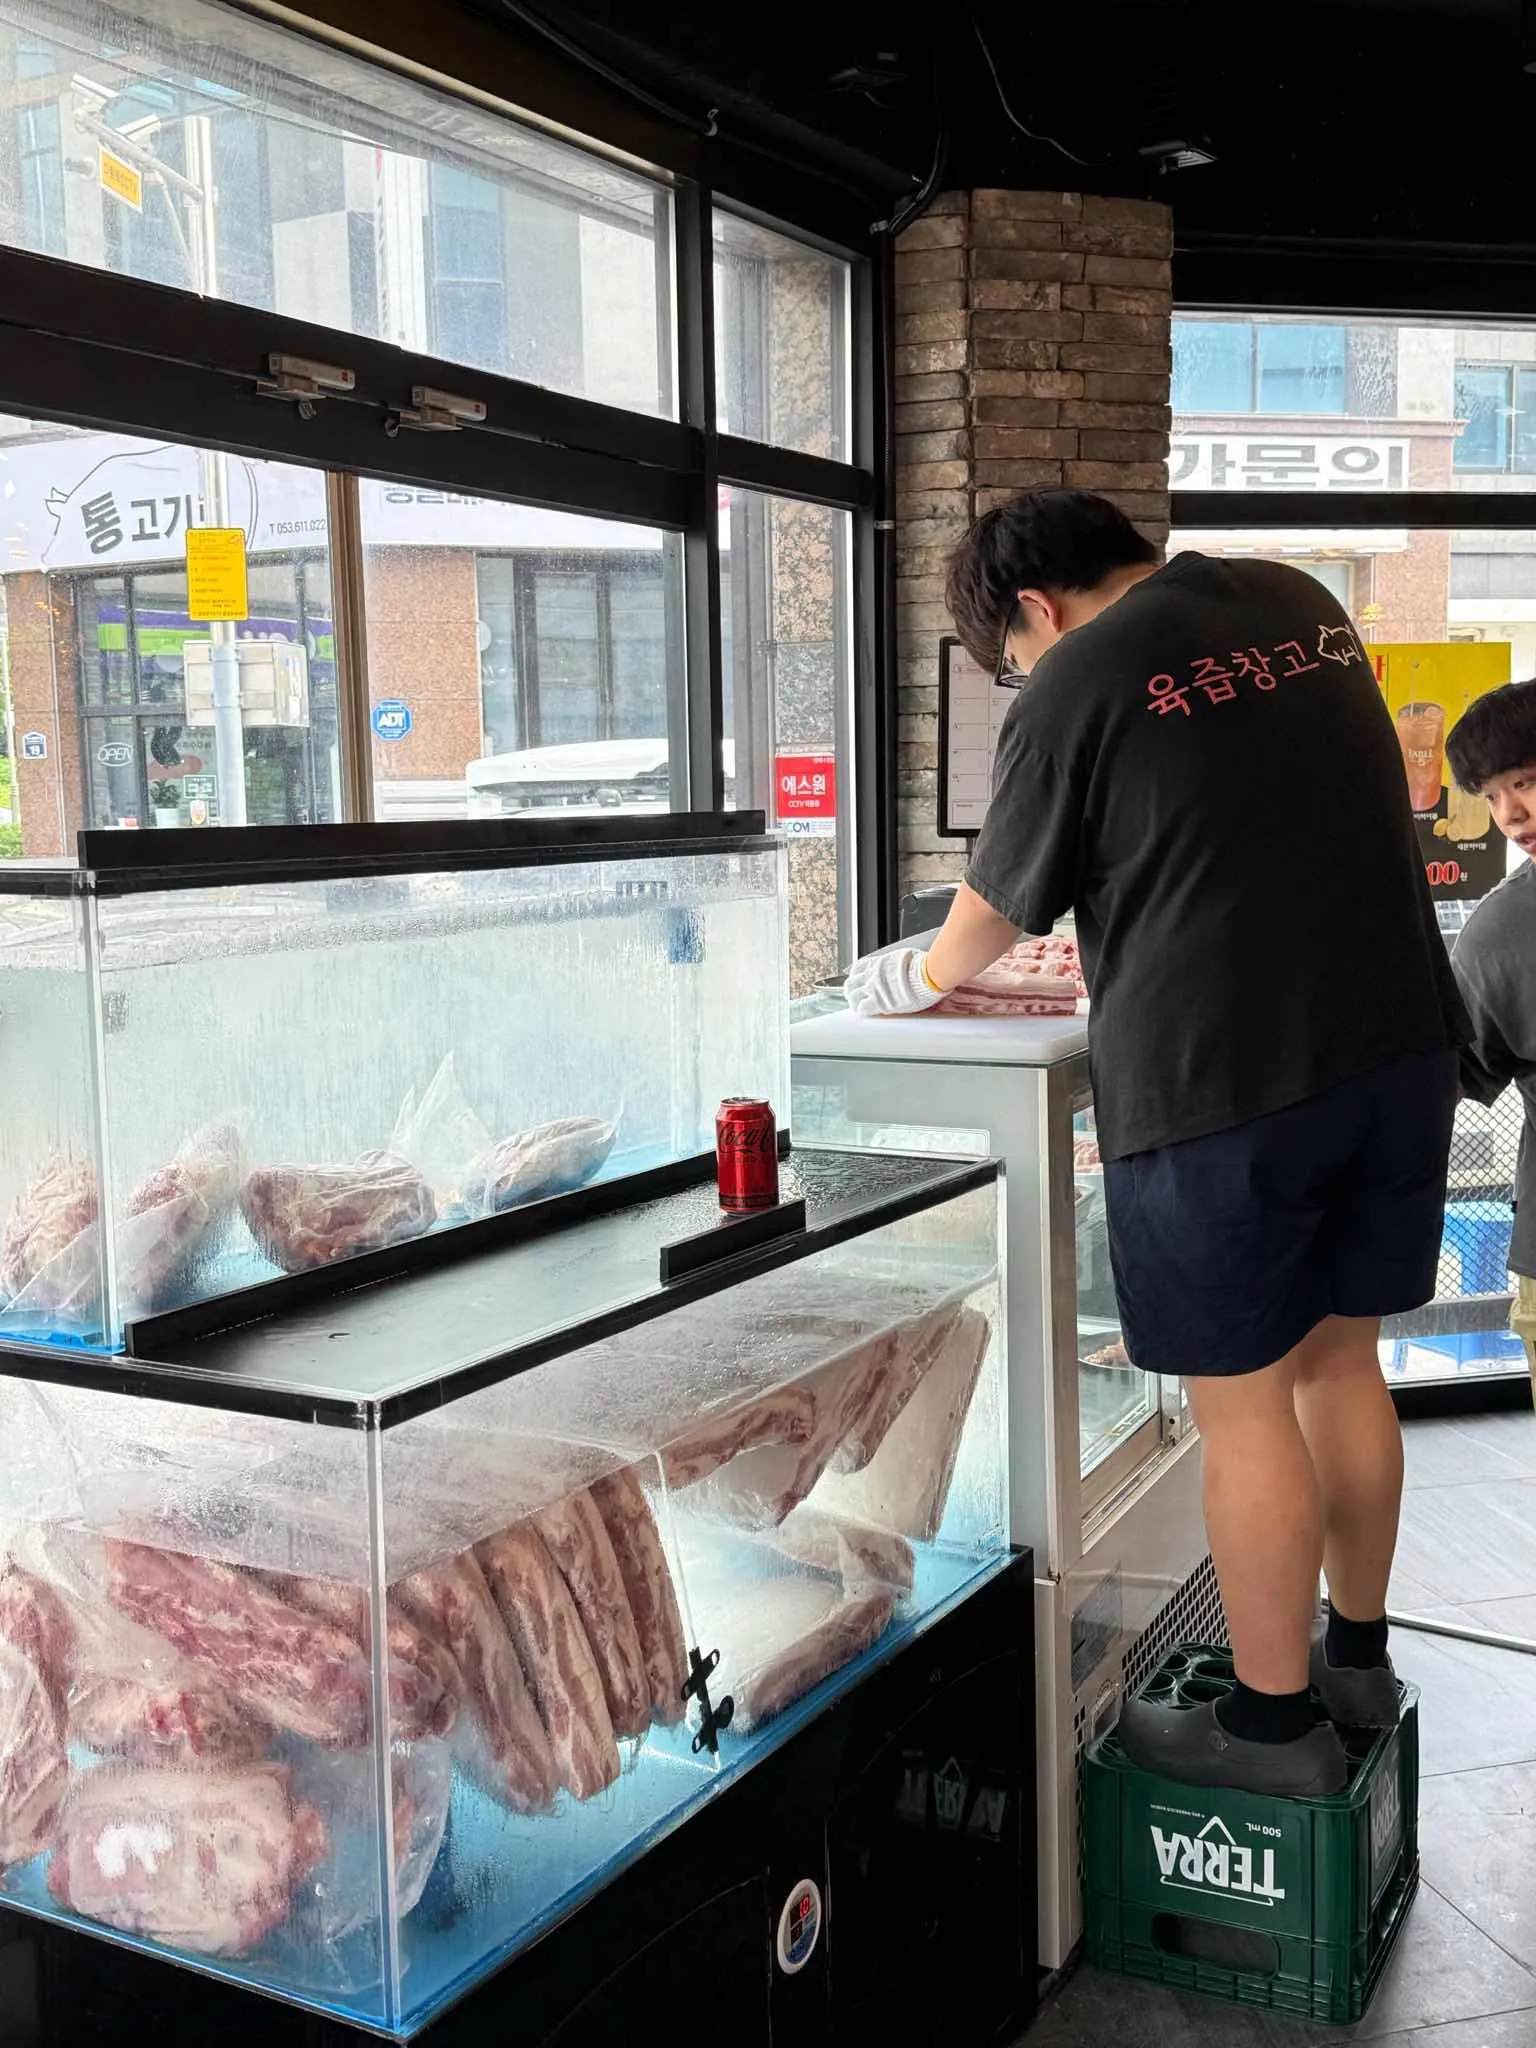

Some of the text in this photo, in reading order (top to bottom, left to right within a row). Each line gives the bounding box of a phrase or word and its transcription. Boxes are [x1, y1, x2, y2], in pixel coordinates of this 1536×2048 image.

[80, 491, 205, 555] 통고기
[1147, 640, 1320, 716] 육즙창고
[378, 711, 403, 728] ADT
[98, 747, 132, 761] OPEN
[782, 774, 826, 796] 에스원
[1245, 1822, 1282, 1838] 500 mL
[1150, 1825, 1285, 1899] TERRA
